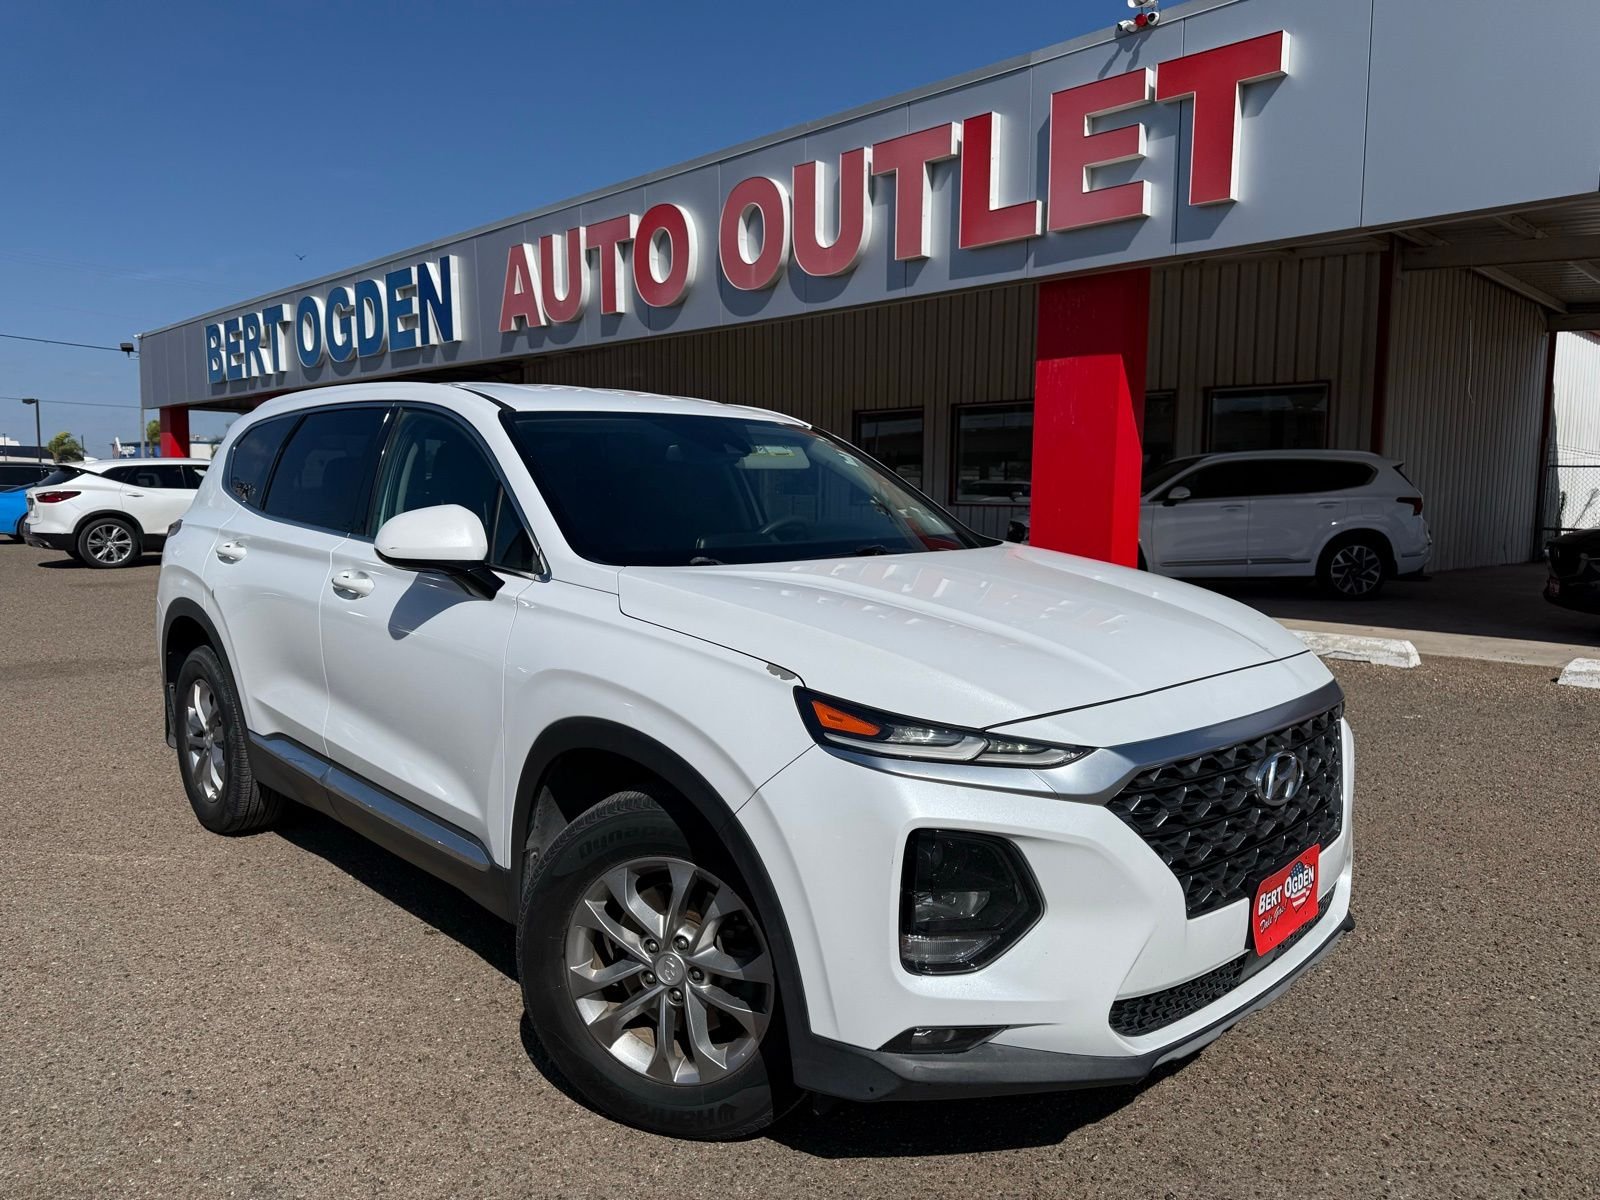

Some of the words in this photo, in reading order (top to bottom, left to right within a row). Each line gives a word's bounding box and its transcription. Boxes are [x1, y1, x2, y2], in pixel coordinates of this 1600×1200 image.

[205, 304, 291, 384] BERT
[296, 255, 462, 368] OGDEN
[499, 202, 697, 332] AUTO
[719, 30, 1290, 290] OUTLET
[1258, 886, 1282, 915] BERT
[1285, 866, 1315, 897] OGDEN
